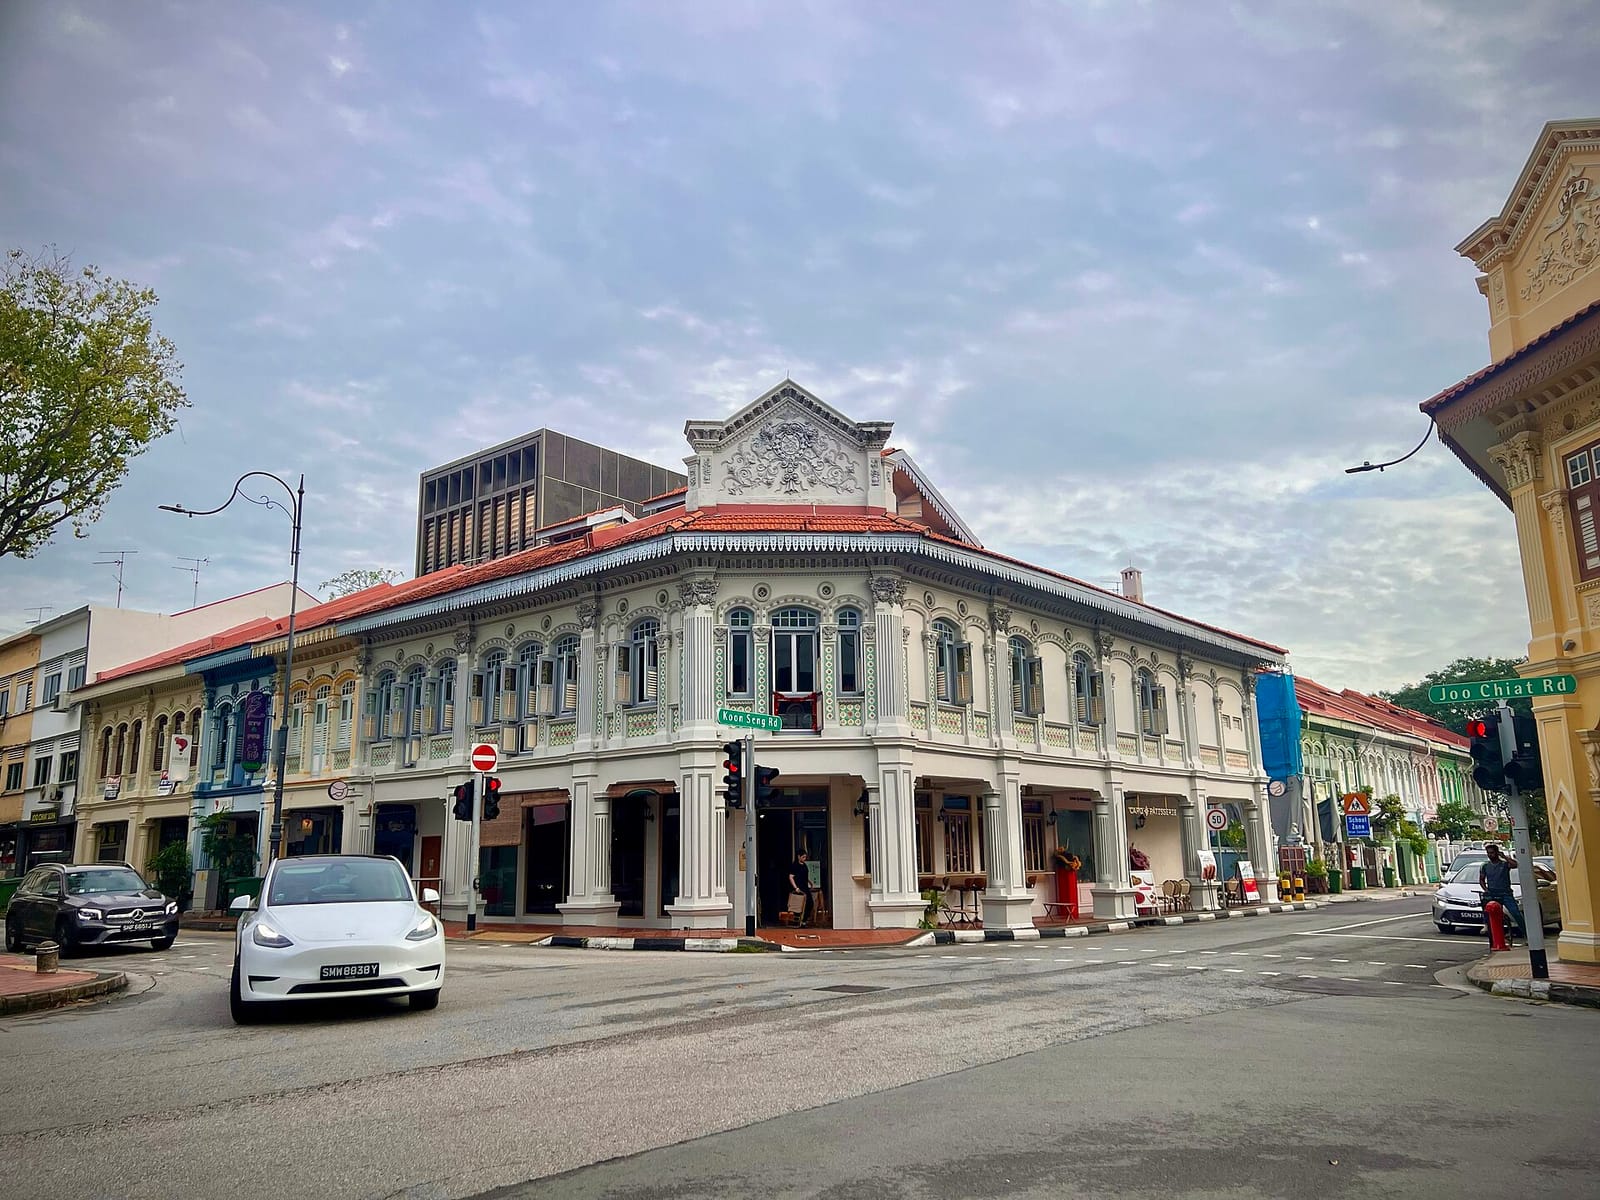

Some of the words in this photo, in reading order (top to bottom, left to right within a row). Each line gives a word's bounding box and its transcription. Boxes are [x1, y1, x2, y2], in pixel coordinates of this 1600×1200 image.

[1440, 687, 1471, 701] Joo
[1480, 681, 1533, 697] Chiat
[1543, 678, 1567, 693] Rd
[722, 711, 744, 723] Koon
[746, 714, 766, 728] Seng
[768, 717, 778, 727] Rd
[1212, 815, 1221, 824] 50
